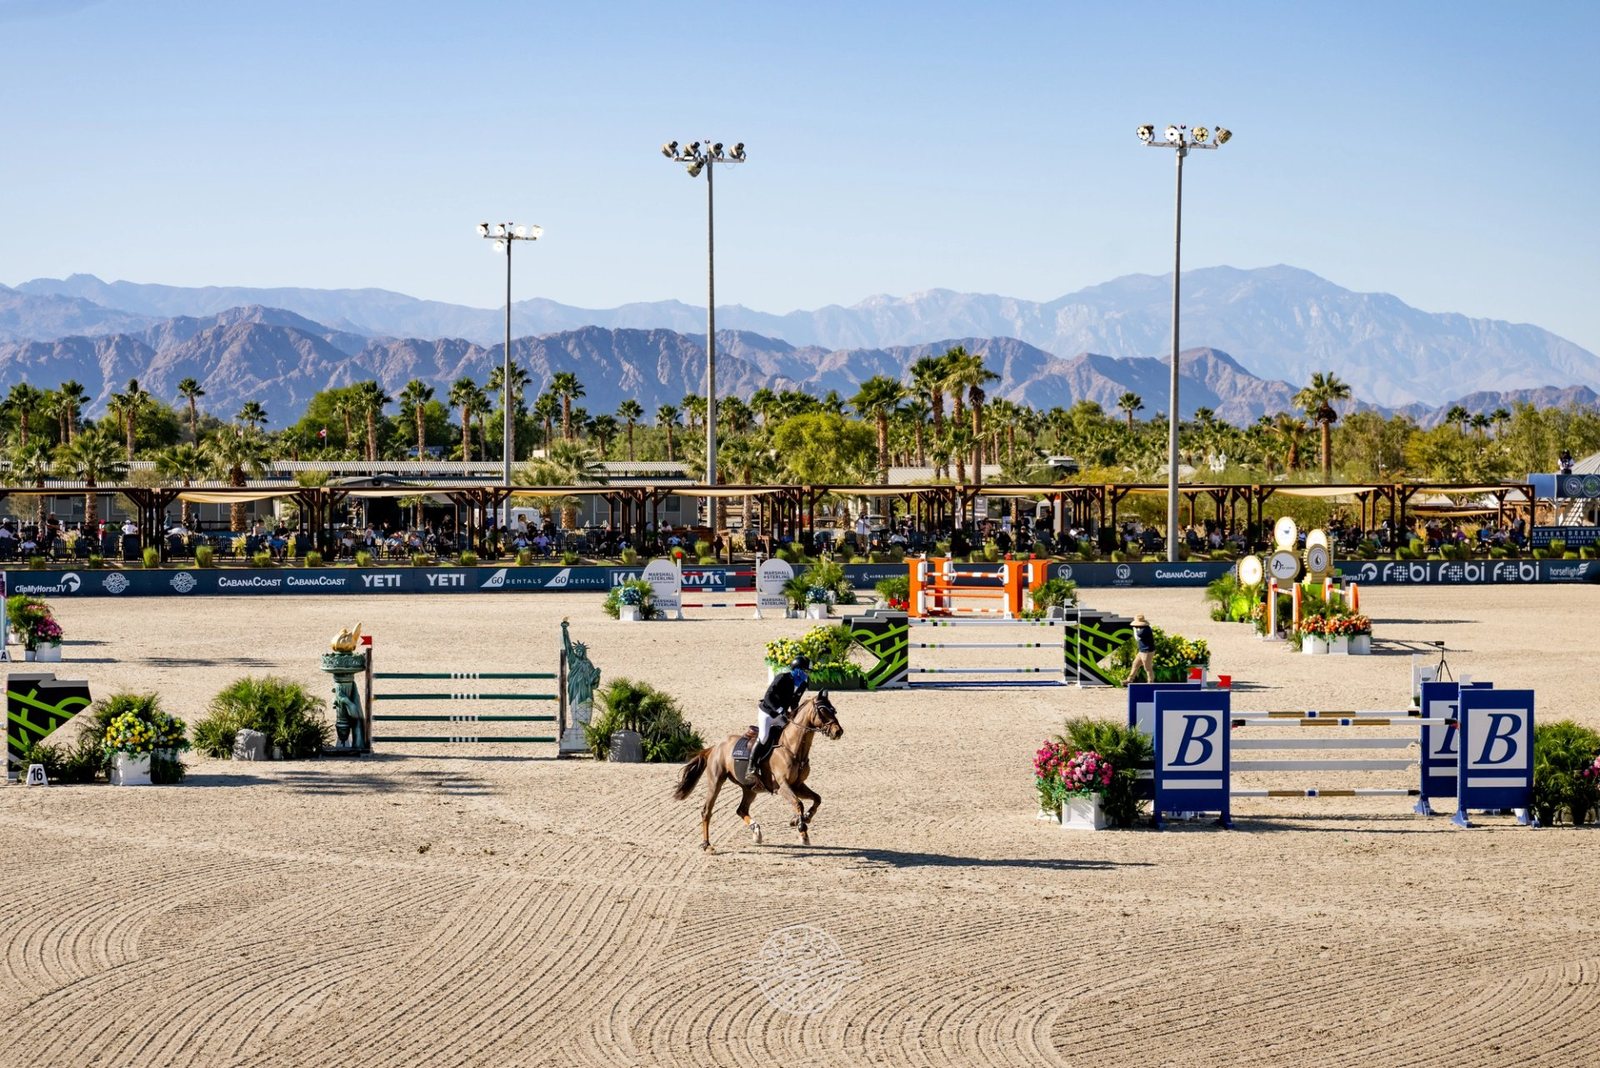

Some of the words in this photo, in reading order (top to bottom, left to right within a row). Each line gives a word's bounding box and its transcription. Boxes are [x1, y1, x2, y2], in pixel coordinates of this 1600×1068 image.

[361, 574, 401, 587] YETI
[426, 574, 465, 586] YETI
[491, 576, 503, 584] GO
[554, 576, 567, 584] GO
[1, 651, 7, 660] A
[1167, 714, 1218, 767] B
[1472, 713, 1522, 765] B
[31, 768, 42, 781] 16
